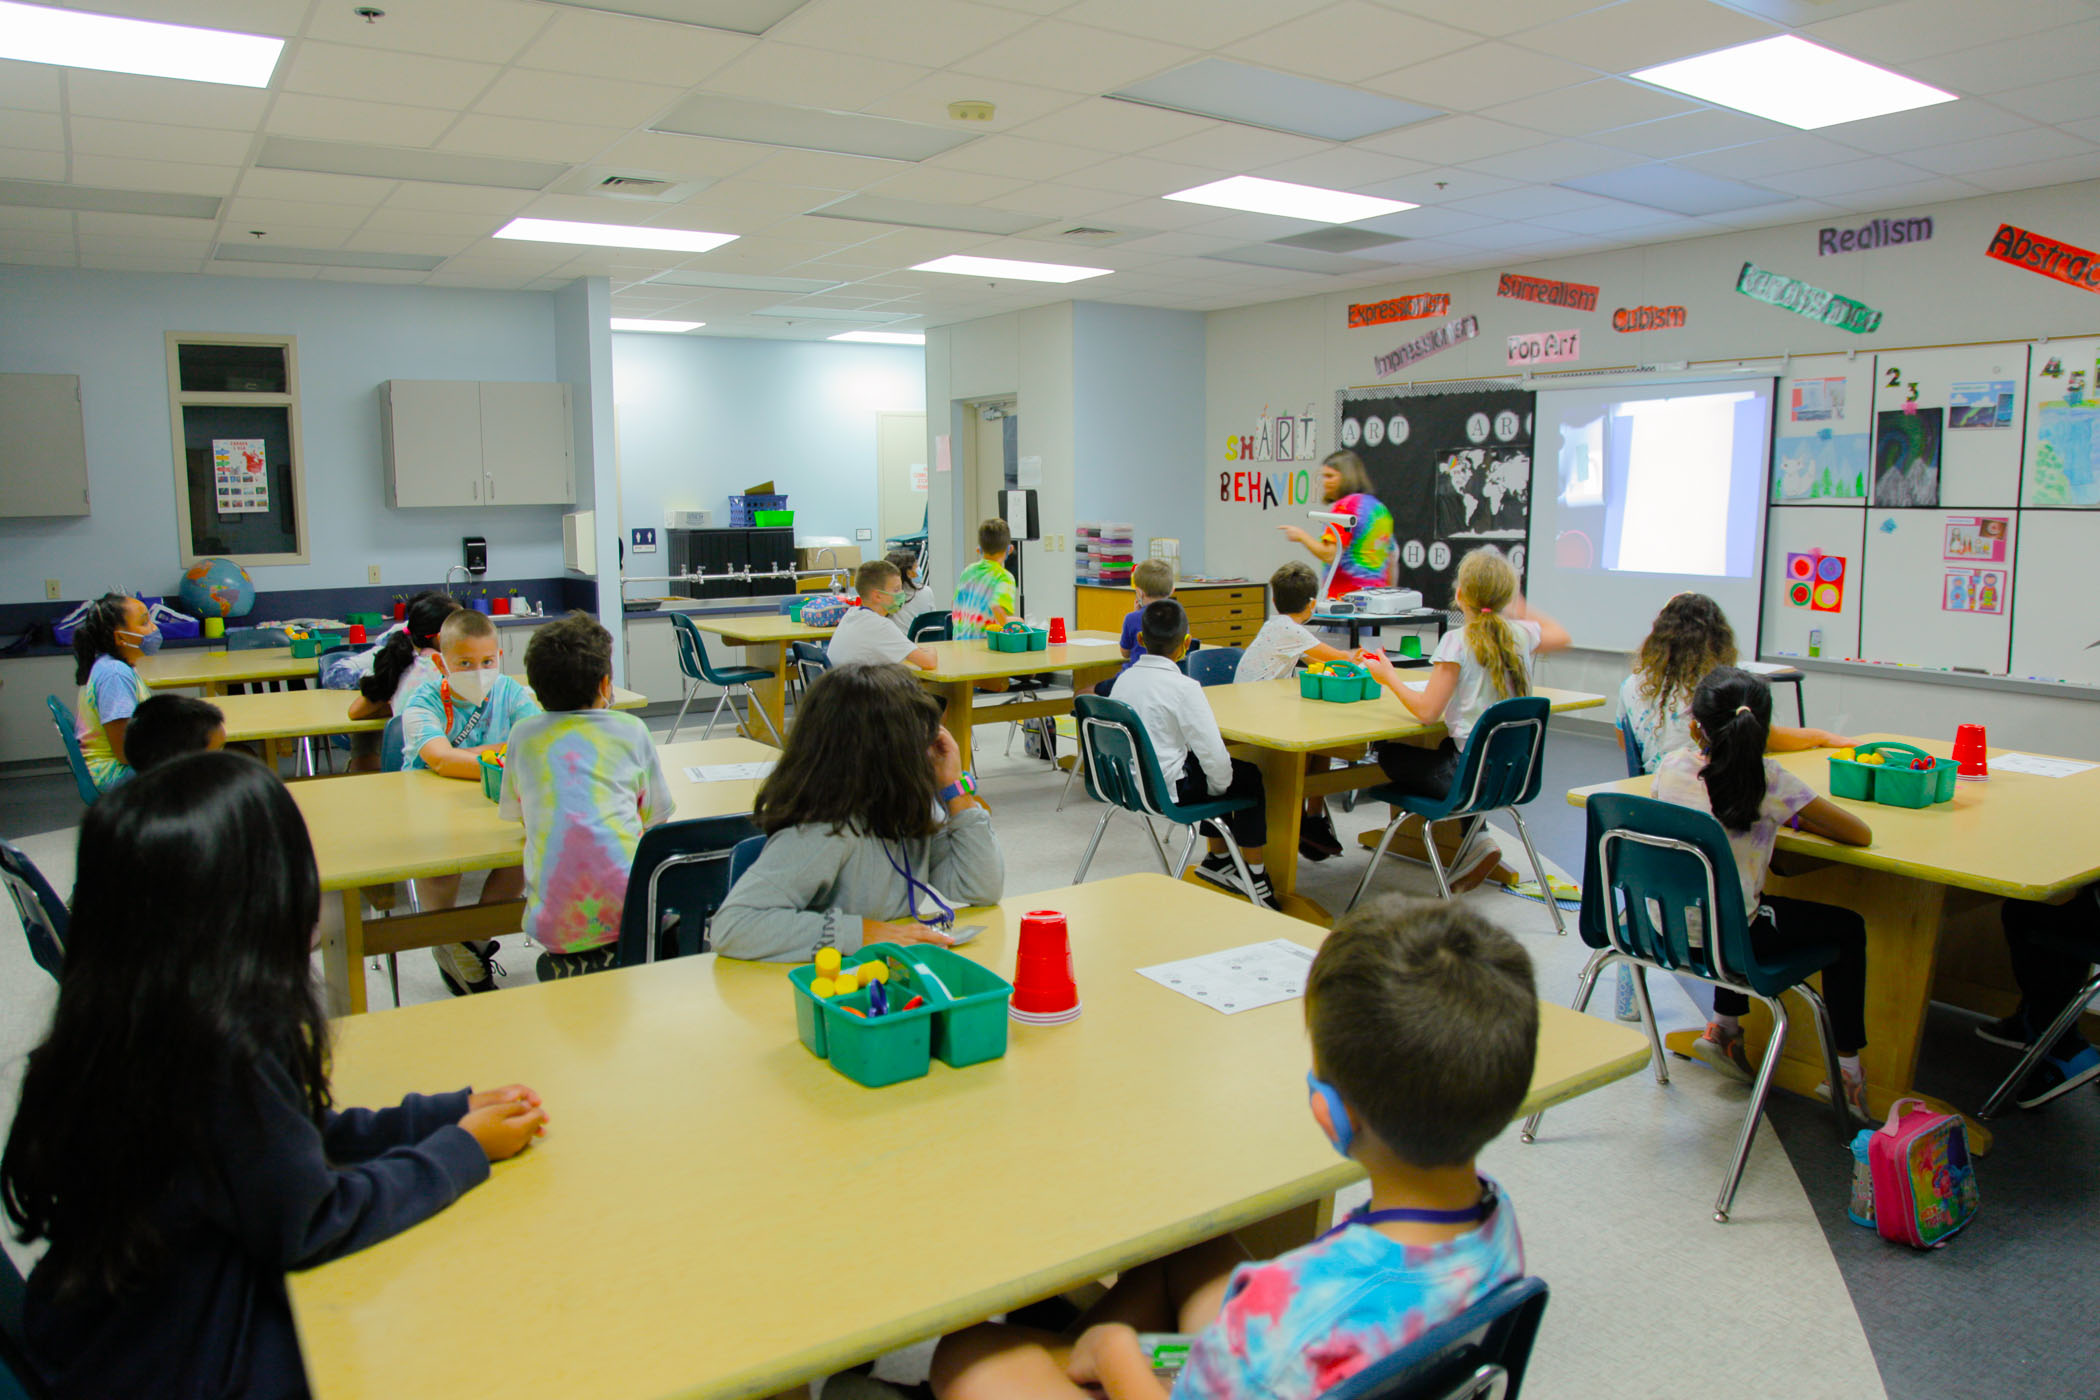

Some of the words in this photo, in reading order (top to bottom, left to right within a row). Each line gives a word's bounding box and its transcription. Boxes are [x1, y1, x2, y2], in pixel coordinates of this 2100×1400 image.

[1819, 216, 1932, 256] Realism
[1499, 273, 1596, 312] Surrealism
[1348, 294, 1450, 325] Expressionism
[1613, 306, 1687, 331] Cubism
[1374, 315, 1479, 375] Impressiosm
[1508, 338, 1540, 362] Pop
[1545, 334, 1576, 356] Art
[1885, 367, 1901, 387] 2
[2040, 357, 2064, 378] 4
[1906, 382, 1919, 402] 3
[1224, 417, 1314, 461] SMART
[1344, 421, 1405, 441] ART
[1471, 416, 1514, 437] AR
[1407, 545, 1446, 566] HE
